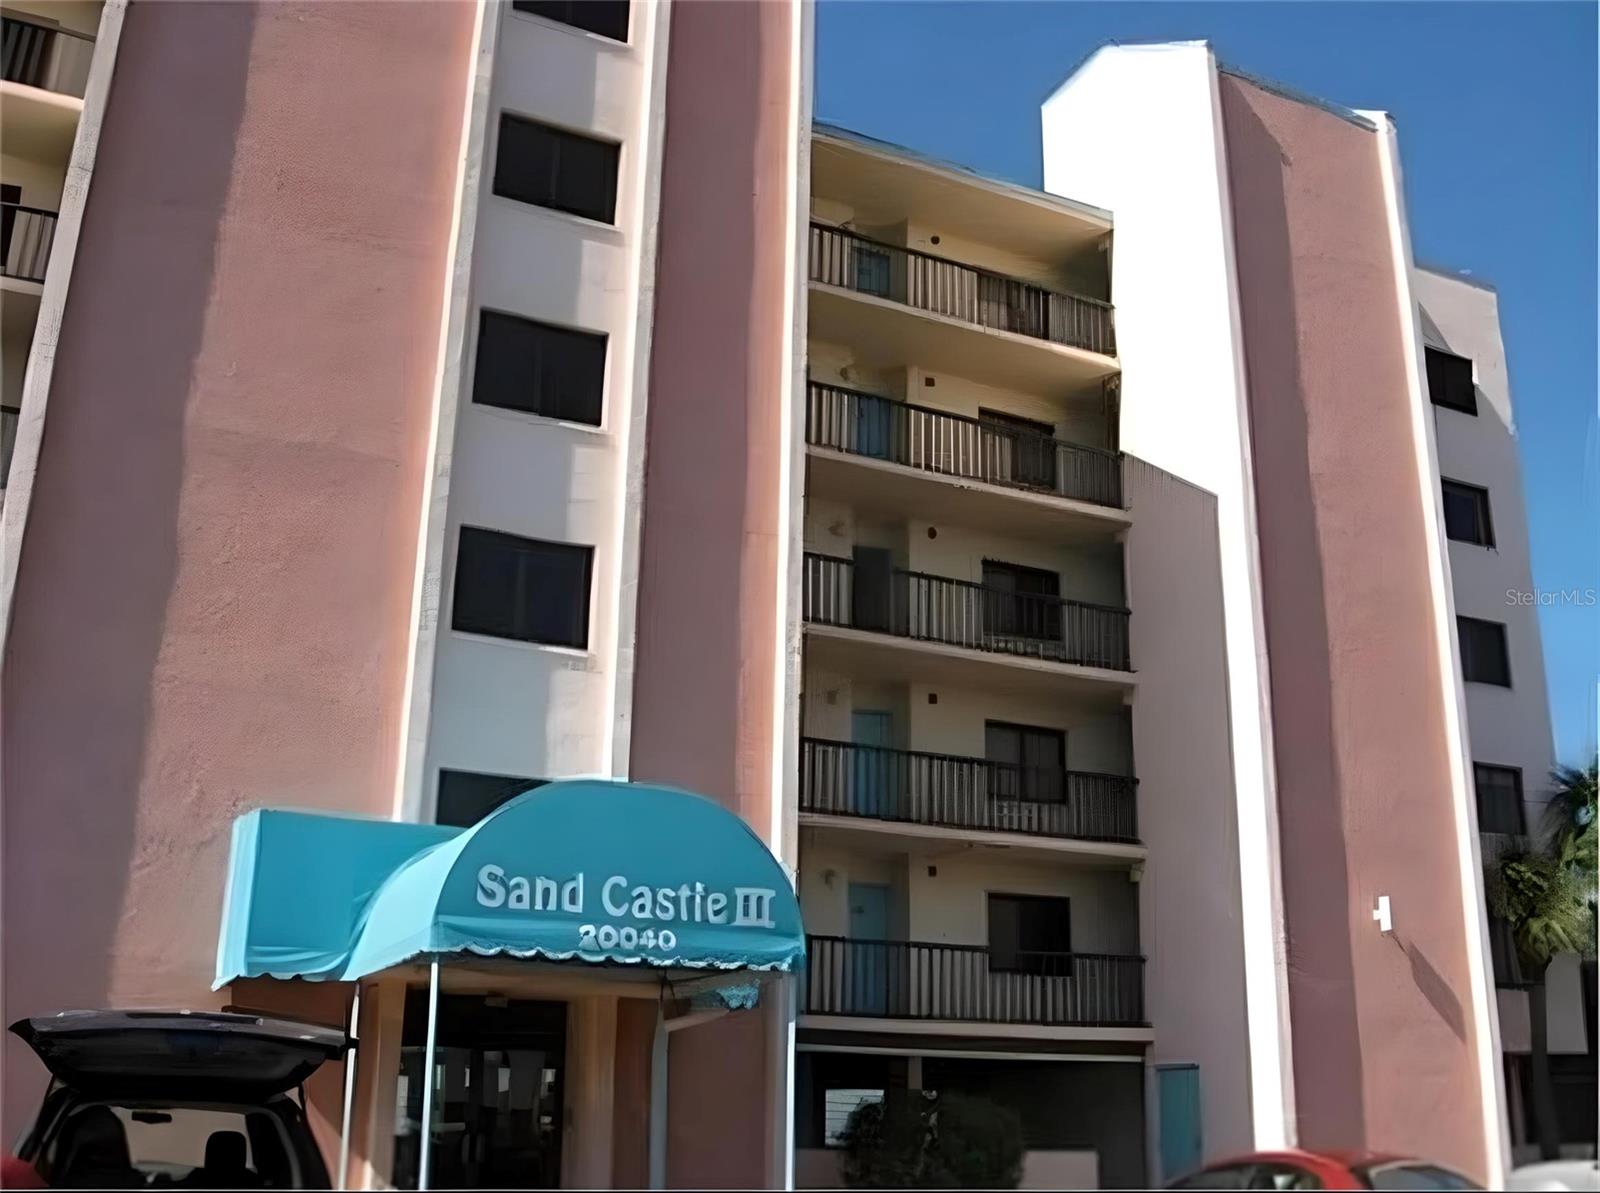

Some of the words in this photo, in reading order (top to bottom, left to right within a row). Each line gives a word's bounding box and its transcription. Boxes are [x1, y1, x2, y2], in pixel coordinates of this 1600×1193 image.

[476, 863, 584, 914] Sand
[731, 887, 776, 928] III
[578, 924, 677, 952] 20040
